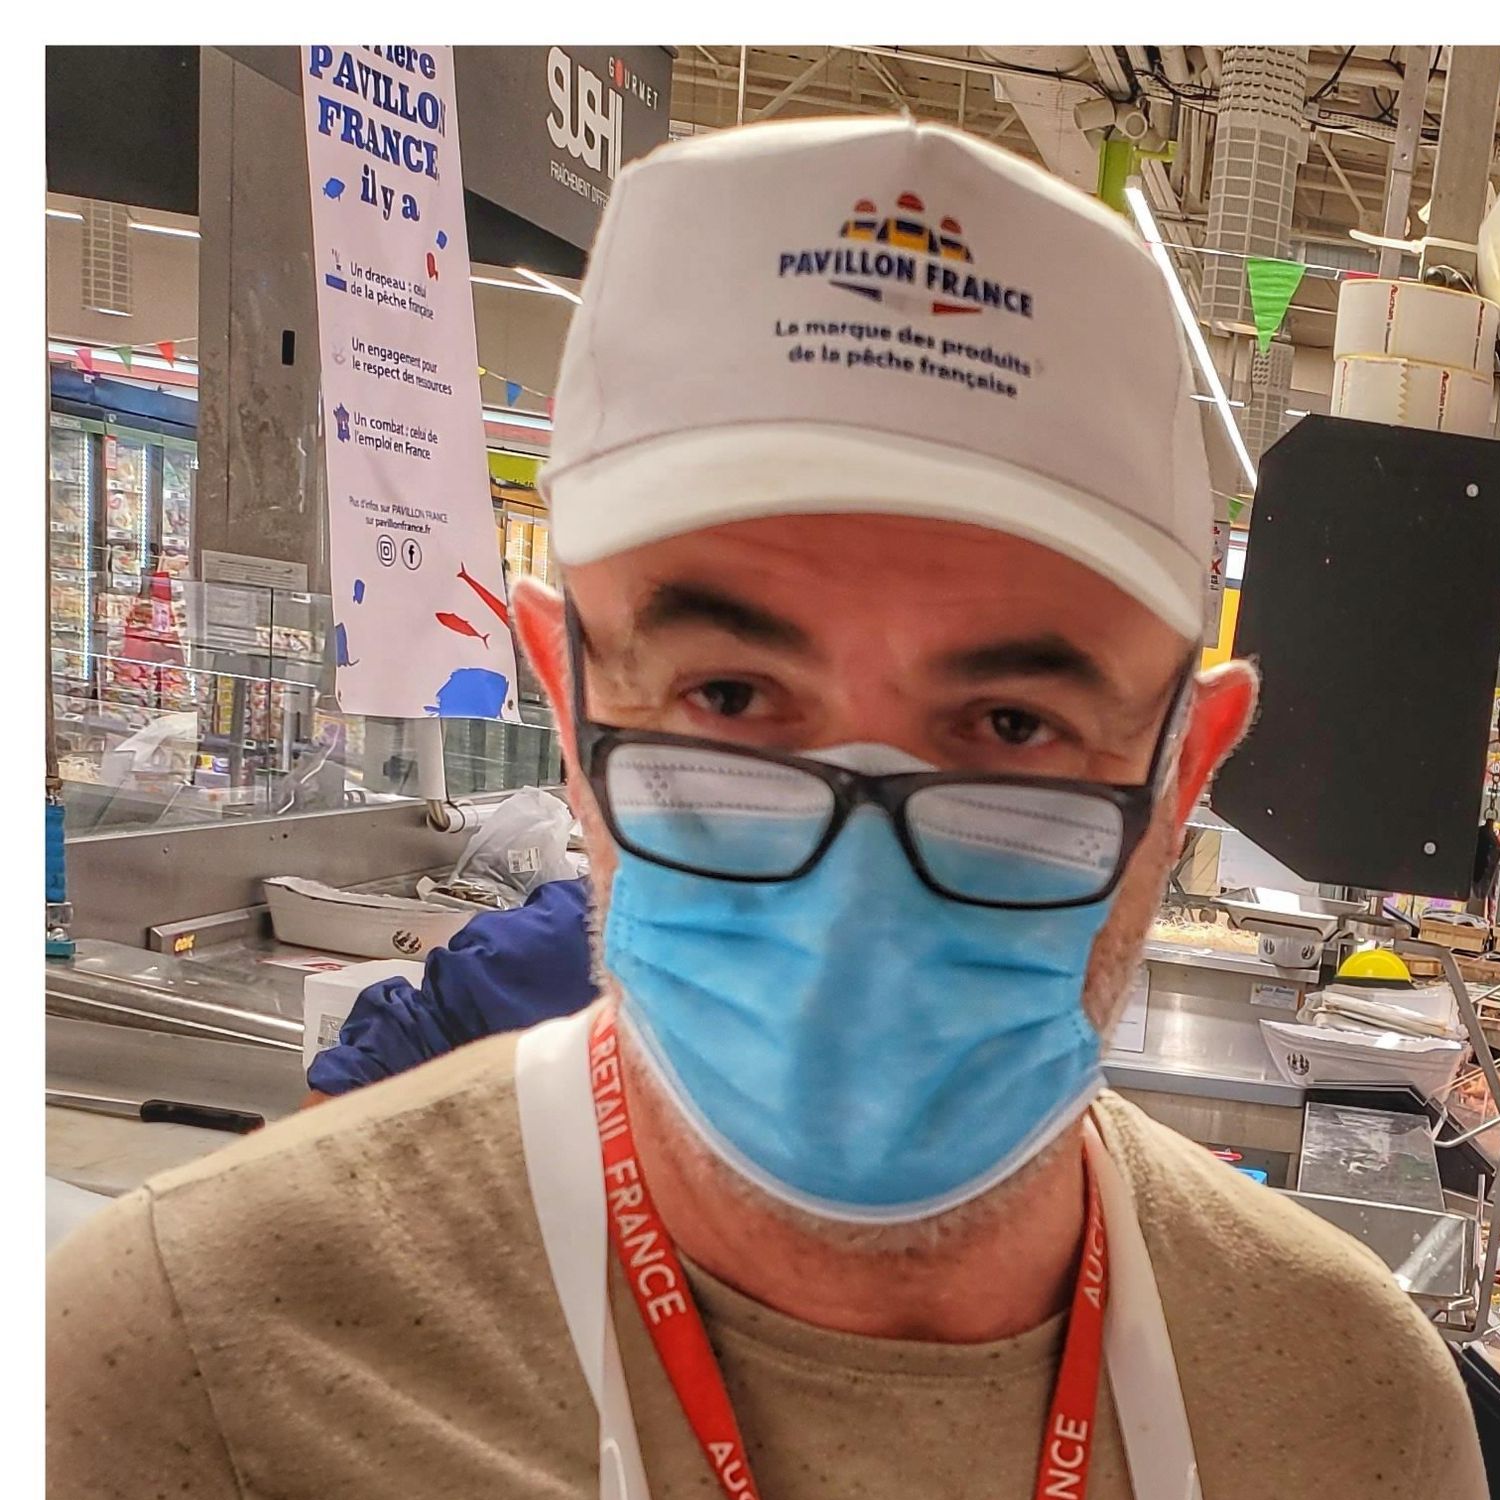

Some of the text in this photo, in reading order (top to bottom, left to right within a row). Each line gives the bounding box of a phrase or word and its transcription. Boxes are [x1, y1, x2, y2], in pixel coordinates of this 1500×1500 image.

[309, 45, 447, 138] PAVILLON
[608, 56, 659, 111] GOURMET
[546, 46, 623, 181] SUSHI
[401, 193, 421, 222] a
[351, 261, 363, 279] Un
[365, 267, 406, 292] drapeau
[351, 282, 362, 298] de
[365, 285, 374, 300] la
[377, 290, 407, 310] pêche
[778, 248, 1034, 319] PAVILLON FRANCE
[352, 337, 438, 374] Un engagement pour
[775, 319, 1032, 379] La marque des produits
[788, 344, 1018, 400] de la pêche française
[352, 355, 452, 396] le respect des ressources
[354, 412, 367, 428] Un
[369, 415, 404, 435] combat
[410, 424, 427, 441] celui
[428, 430, 438, 444] de
[393, 442, 404, 454] en
[405, 443, 431, 460] France
[392, 504, 425, 519] PAVILLON
[592, 1026, 628, 1141] RETAIL
[605, 1158, 687, 1326] FRANCE
